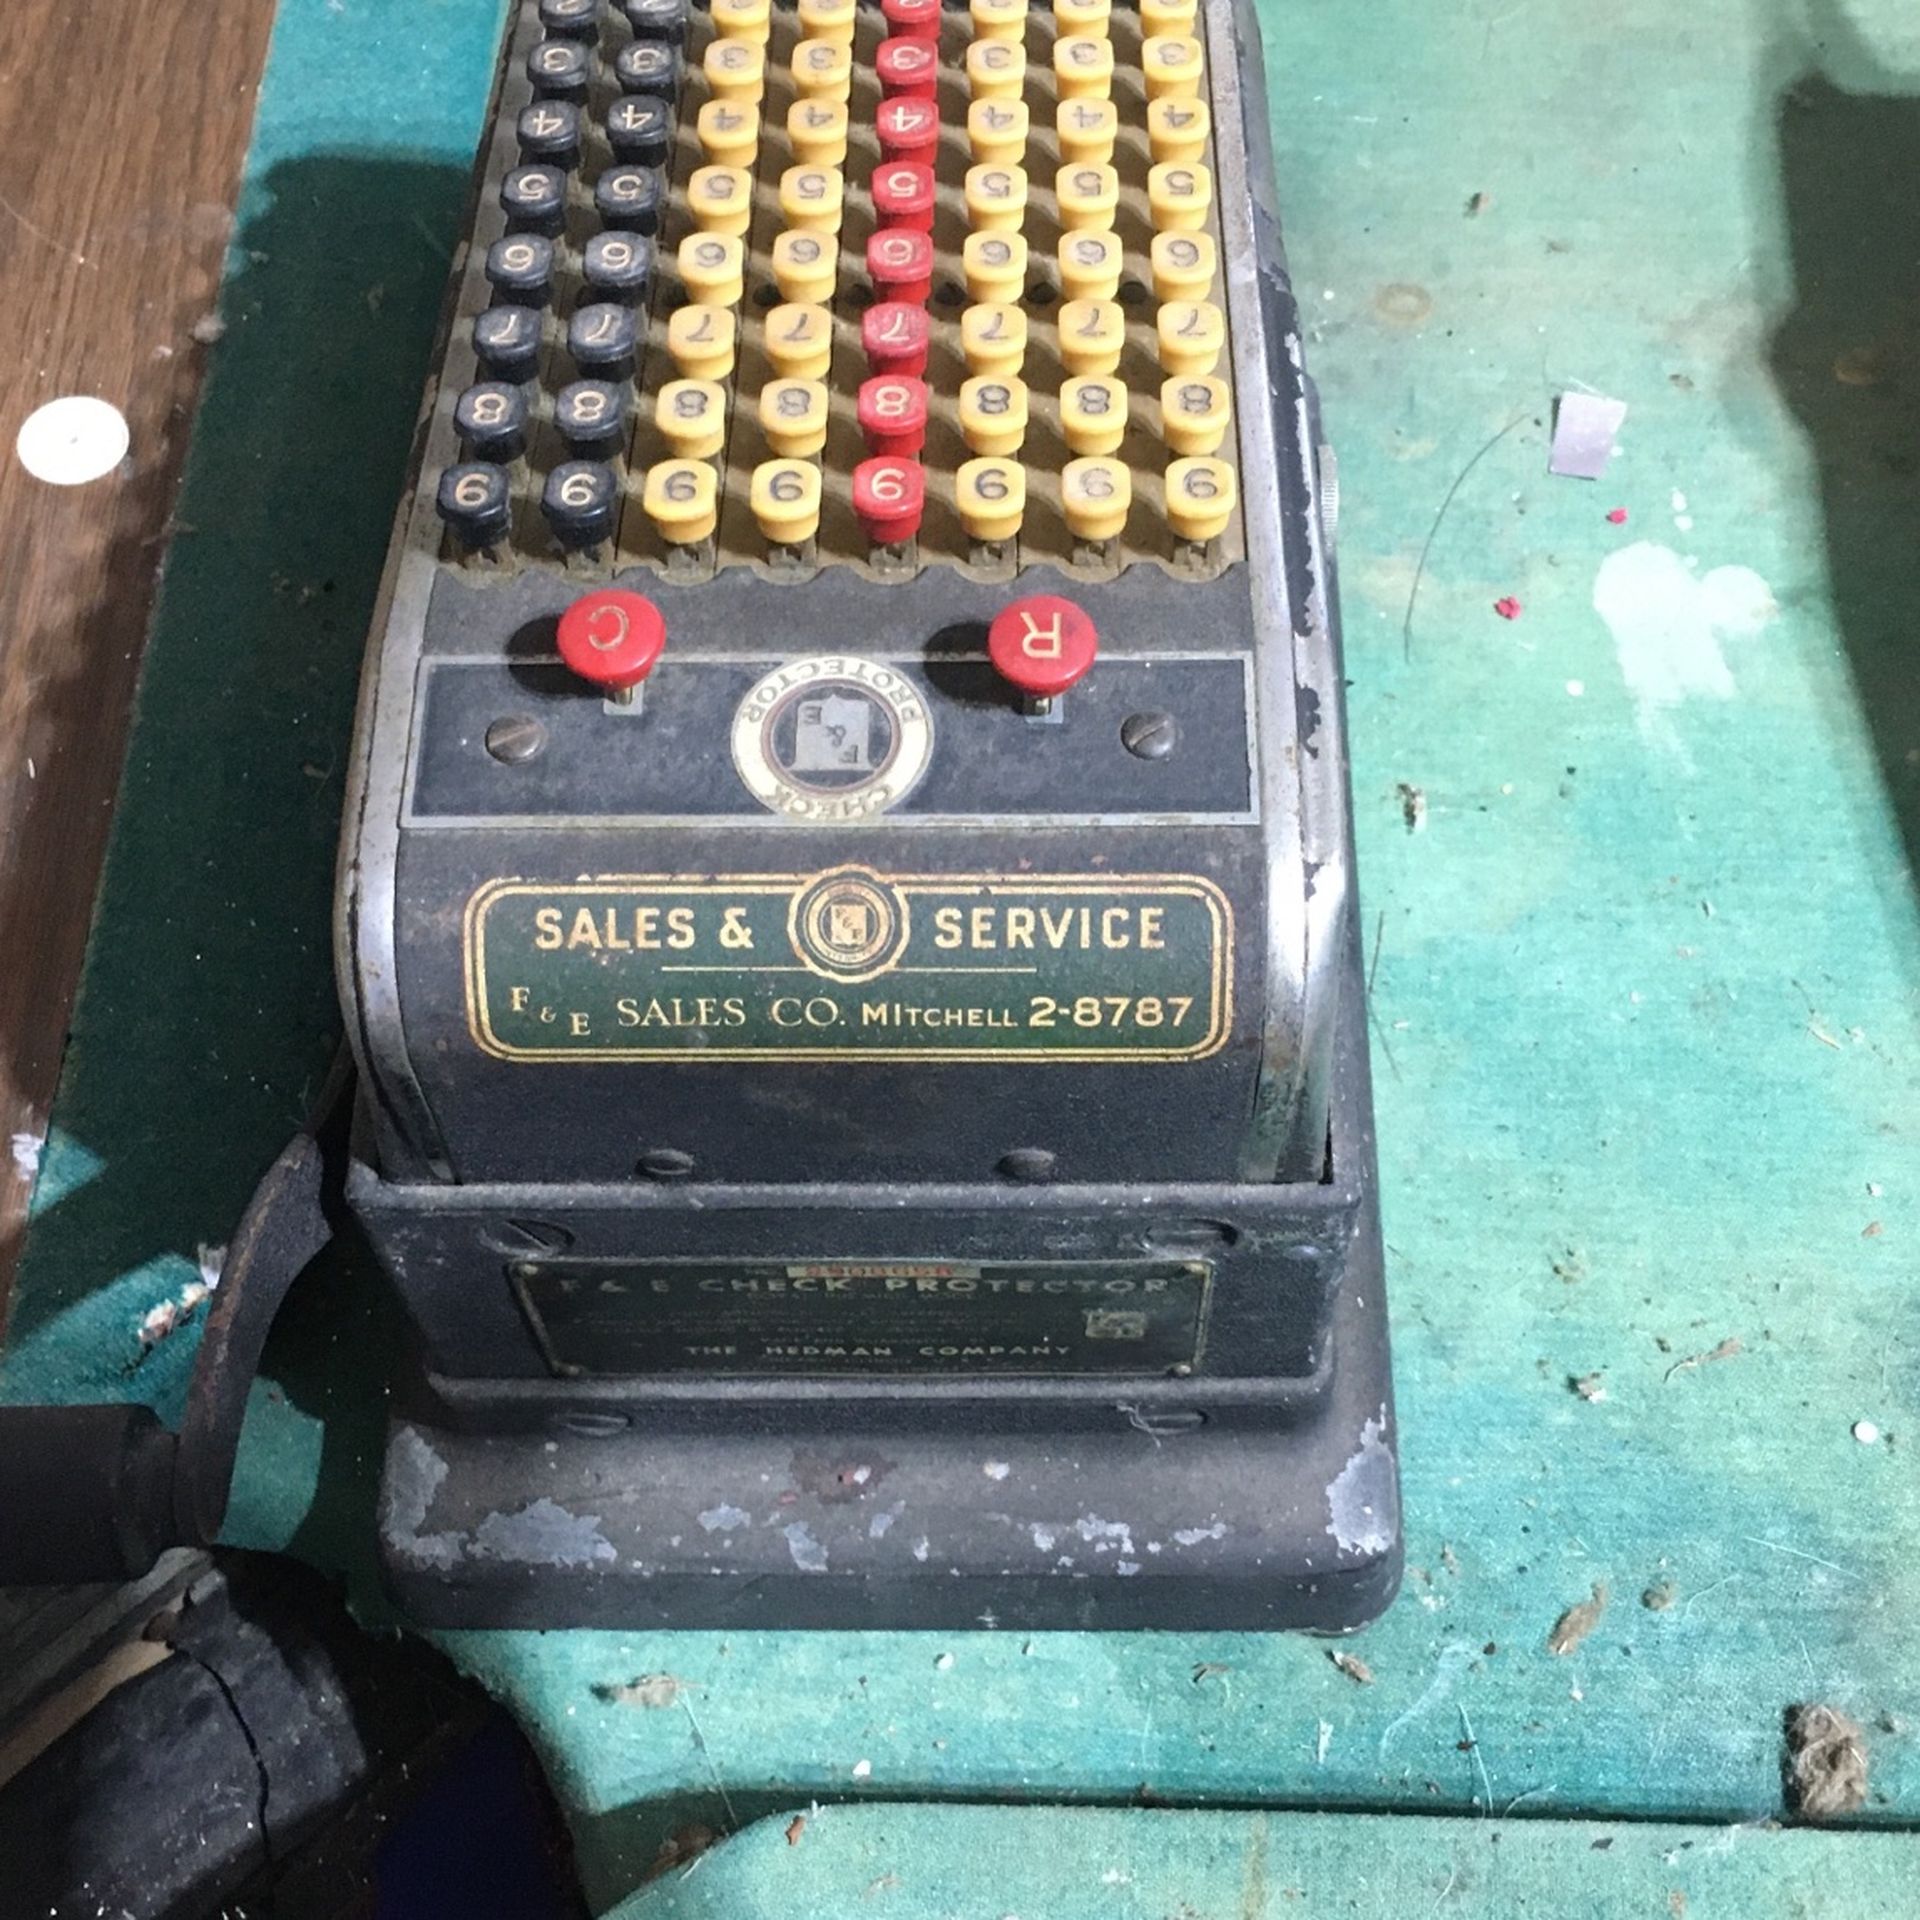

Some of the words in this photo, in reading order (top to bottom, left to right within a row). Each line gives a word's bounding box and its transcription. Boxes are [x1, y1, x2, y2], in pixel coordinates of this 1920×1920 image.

[543, 47, 574, 71] 3
[633, 48, 664, 71] 3
[720, 47, 749, 70] 3
[809, 47, 837, 70] 3
[892, 46, 930, 70] 3
[981, 46, 1012, 69] 3
[1070, 42, 1099, 66] 3
[1157, 43, 1188, 65] 3
[533, 109, 564, 136] 4
[622, 104, 654, 130] 4
[713, 107, 745, 131] 4
[806, 105, 834, 128] 4
[891, 106, 924, 133] 4
[982, 105, 1014, 129] 4
[1072, 106, 1104, 129] 4
[1163, 105, 1195, 128] 4
[518, 173, 551, 200] 5
[611, 174, 644, 200] 5
[706, 174, 736, 199] 5
[798, 174, 827, 199] 5
[888, 171, 918, 198] 5
[981, 172, 1011, 197] 5
[1073, 171, 1103, 197] 5
[1164, 171, 1194, 195] 5
[489, 314, 518, 342] 7
[585, 314, 614, 341] 7
[685, 313, 715, 342] 7
[782, 313, 812, 341] 7
[879, 312, 909, 342] 7
[979, 311, 1009, 341] 7
[1076, 308, 1106, 337] 7
[1177, 308, 1207, 337] 7
[472, 392, 507, 424] 8
[573, 390, 607, 422] 8
[674, 389, 709, 418] 8
[777, 388, 811, 417] 8
[875, 385, 910, 417] 8
[976, 384, 1011, 415] 8
[1076, 384, 1111, 414] 8
[1177, 384, 1213, 414] 8
[589, 605, 630, 652] C
[1020, 612, 1062, 660] R
[742, 658, 924, 724] PROTECTOR
[804, 706, 822, 725] E
[826, 726, 847, 747] &
[838, 745, 859, 764] F
[765, 785, 891, 819] CHECK
[535, 907, 695, 950] SALES
[719, 907, 754, 948] &
[934, 907, 1165, 949] SERVICE
[510, 986, 530, 1012] F
[540, 1006, 557, 1023] &
[570, 1012, 591, 1036] E
[616, 998, 746, 1027] SALES
[771, 997, 846, 1026] CO.
[1029, 996, 1194, 1027] 2-8787
[699, 1277, 852, 1294] CHECK
[885, 1278, 1168, 1294] PROTECTOR
[685, 1346, 737, 1355] THE
[919, 1346, 1070, 1355] COMPANY
